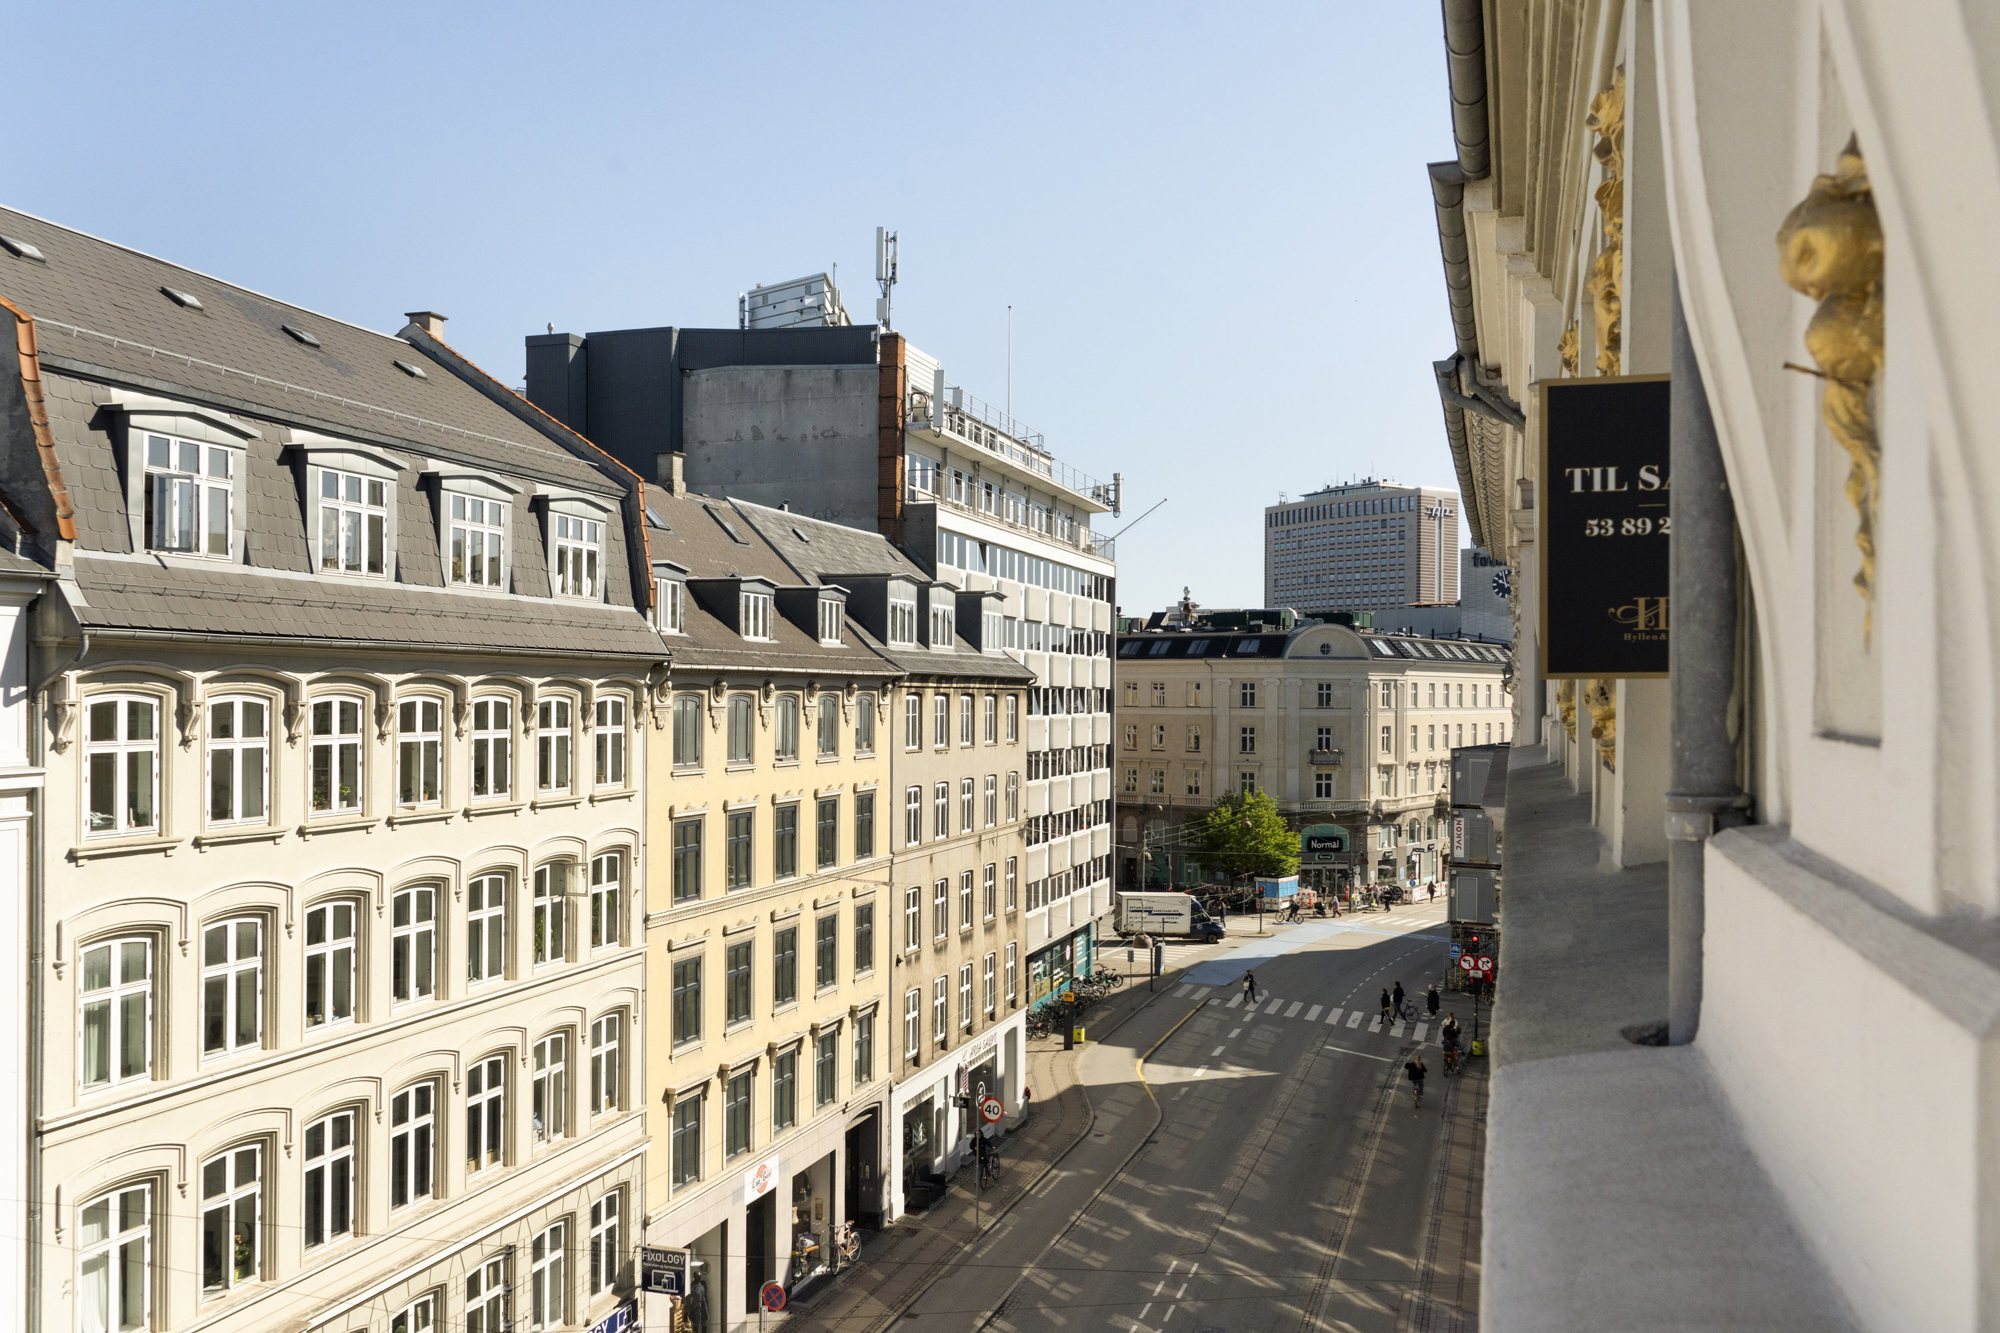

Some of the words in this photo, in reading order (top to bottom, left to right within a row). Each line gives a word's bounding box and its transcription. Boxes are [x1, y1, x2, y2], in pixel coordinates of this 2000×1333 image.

[1565, 466, 1628, 493] TIL
[1638, 464, 1670, 491] S
[1585, 519, 1614, 536] 53
[1621, 517, 1651, 535] 89
[1311, 839, 1339, 849] Normal
[984, 1104, 1000, 1115] 40
[642, 1250, 686, 1265] FIXOLOGY
